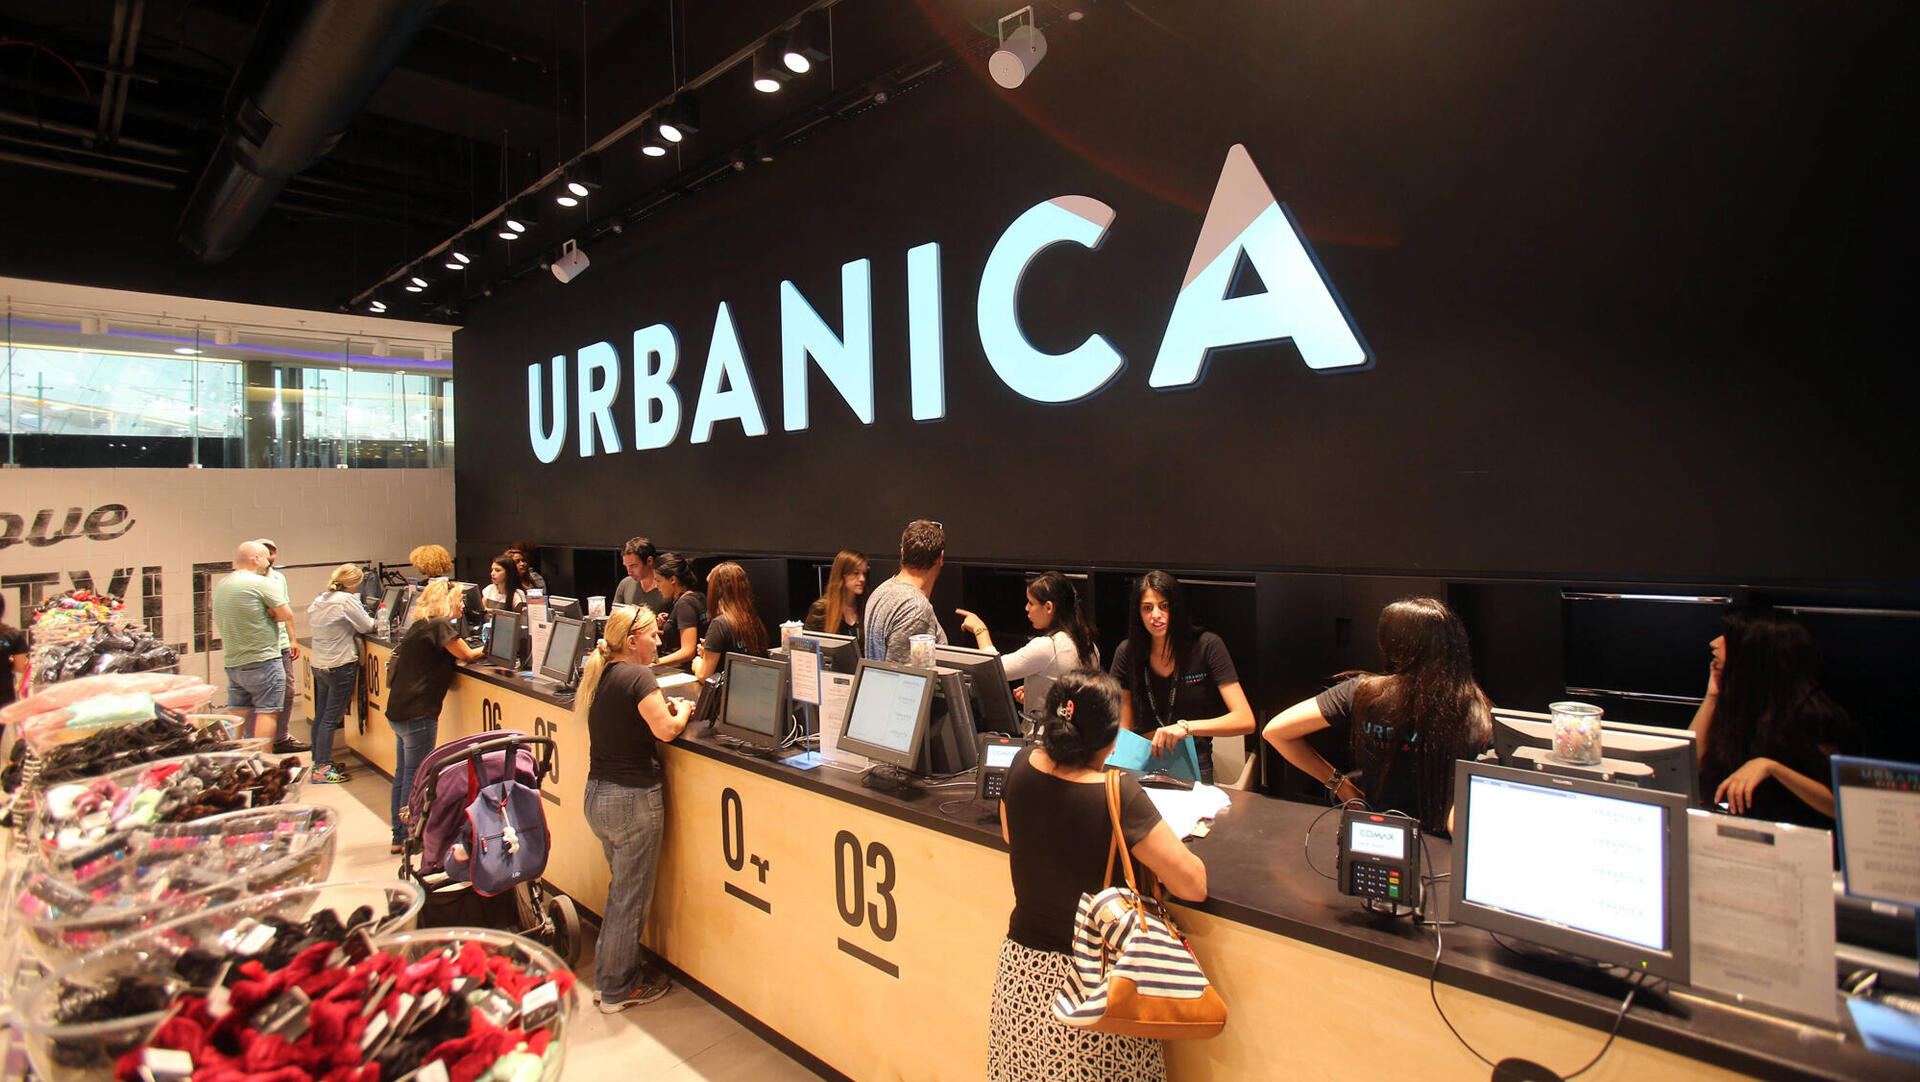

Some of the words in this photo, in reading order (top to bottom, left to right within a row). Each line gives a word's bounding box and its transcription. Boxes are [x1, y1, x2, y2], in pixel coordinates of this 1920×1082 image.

[527, 143, 1370, 464] URBANICA
[368, 653, 379, 696] 08
[834, 829, 898, 942] 03
